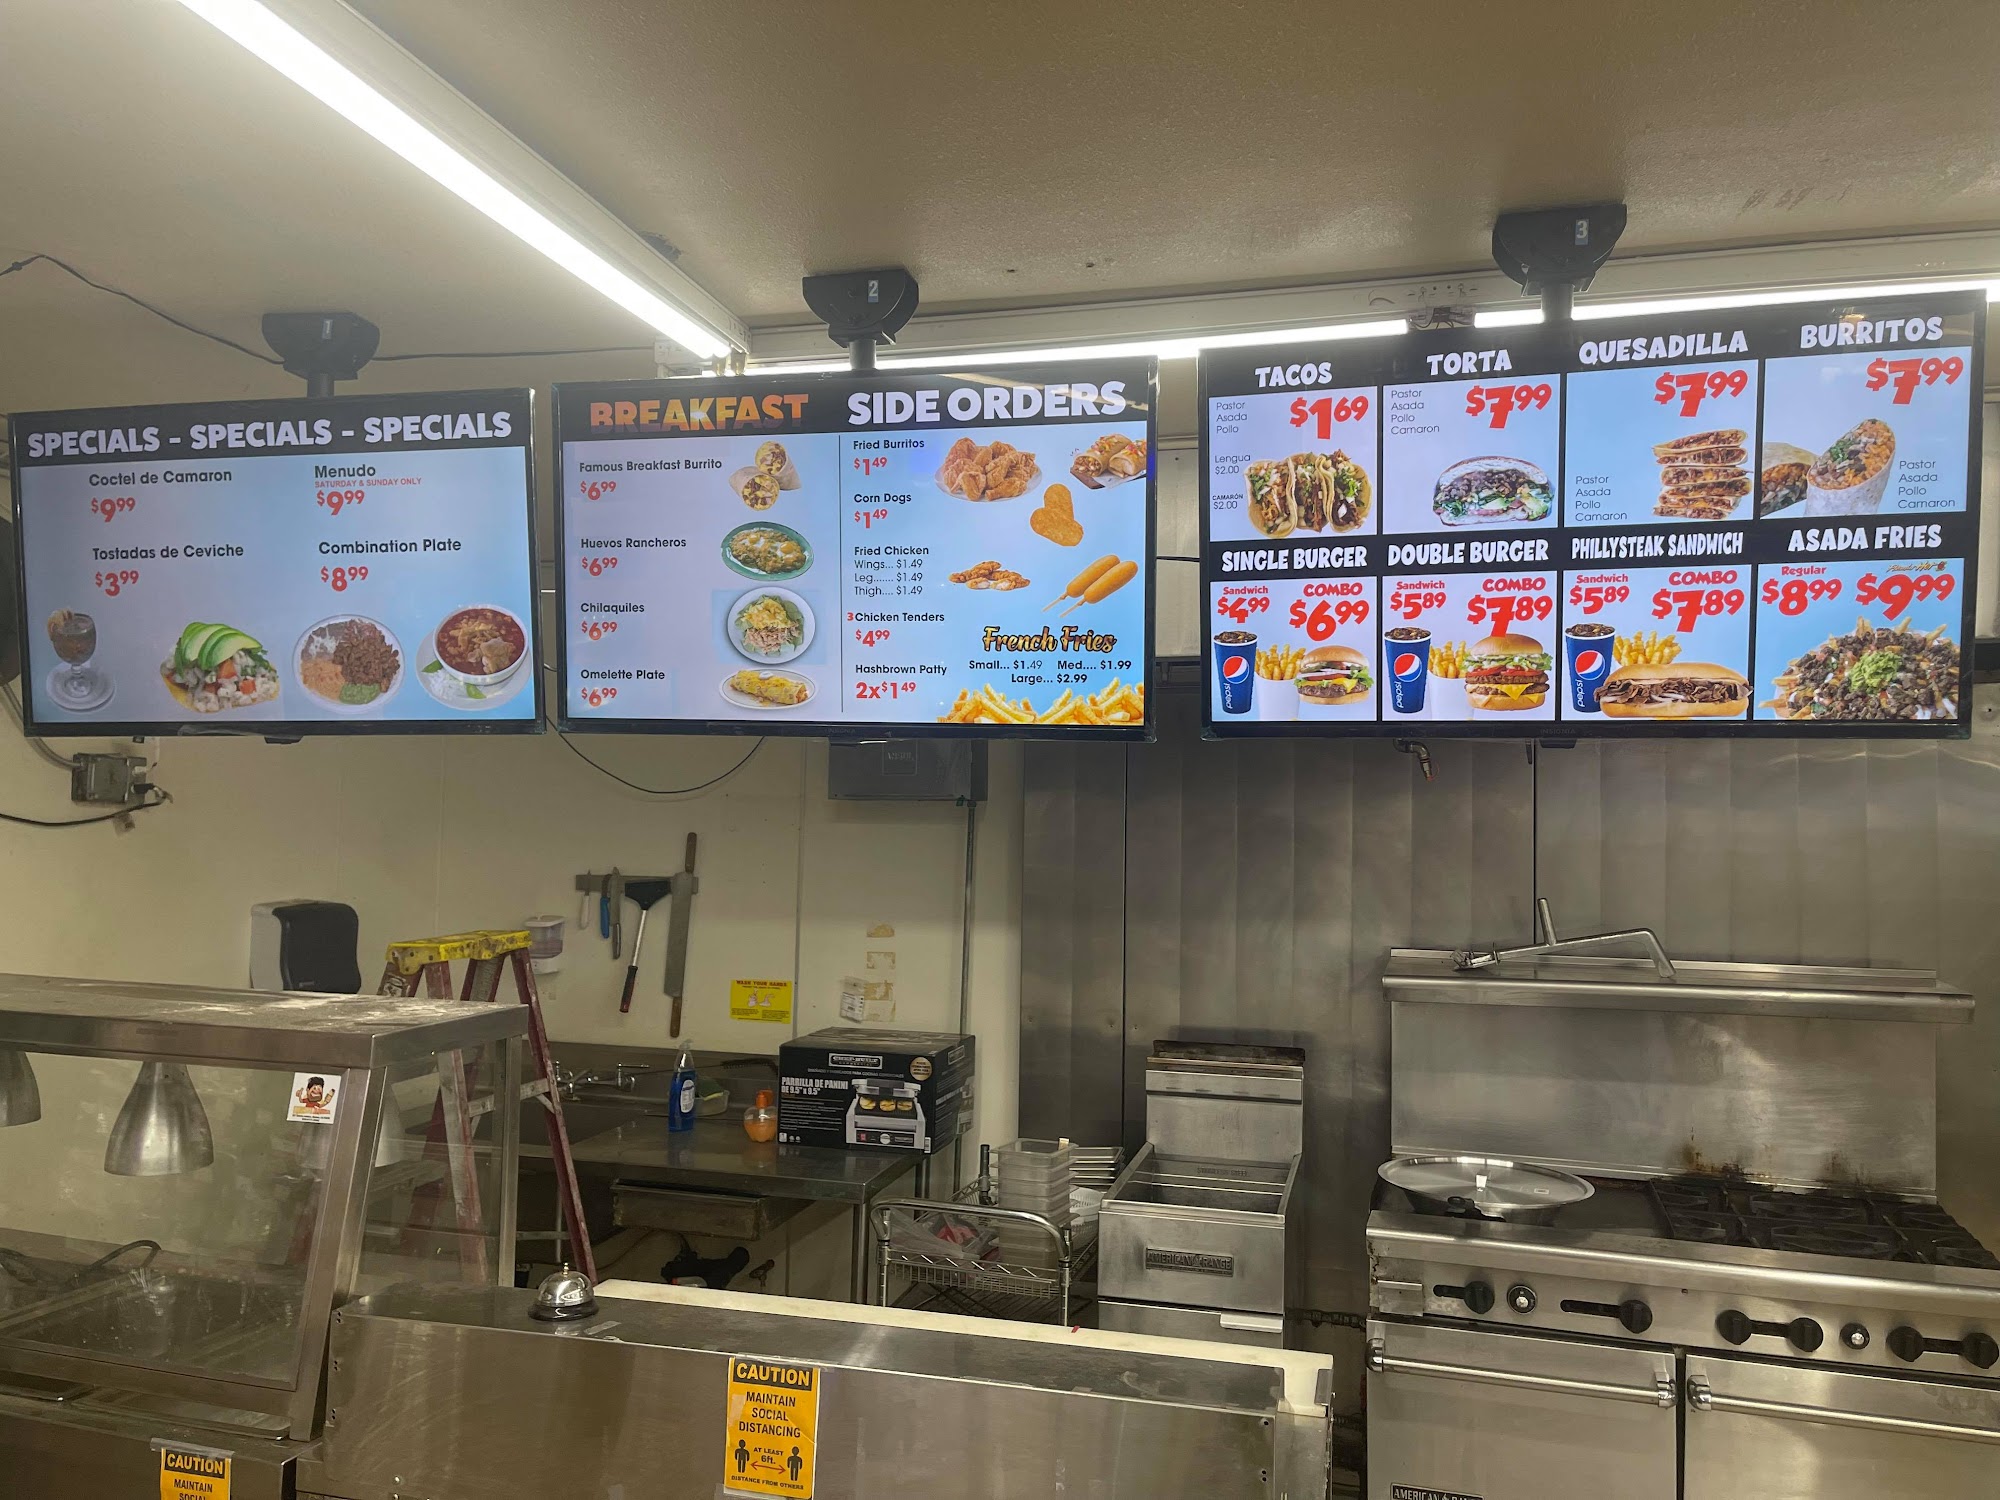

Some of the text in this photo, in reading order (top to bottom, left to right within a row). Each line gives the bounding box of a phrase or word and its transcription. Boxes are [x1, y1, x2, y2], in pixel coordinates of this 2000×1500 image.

[1576, 220, 1588, 239] 3
[868, 280, 878, 297] 2
[1800, 316, 1943, 349] BURRITOS
[1578, 330, 1749, 365] QUESADILLA
[1426, 349, 1512, 376] TORTA
[1254, 361, 1333, 388] TACOS
[1390, 388, 1422, 399] Pastor
[848, 381, 1127, 425] SIDE ORDERS
[1216, 401, 1245, 411] Pastor
[1390, 400, 1424, 411] Asada
[590, 393, 809, 434] BREAKFAST
[1216, 412, 1248, 422] Asada
[1390, 413, 1415, 423] Pollo
[27, 427, 160, 458] SPECIALS
[189, 419, 332, 450] SPECIALS
[363, 411, 512, 443] SPECIALS
[1216, 424, 1239, 434] Pollo
[1390, 424, 1440, 435] Camaron
[853, 438, 925, 450] Fried Burritos
[579, 458, 722, 472] Famous Breakfast Burrito
[1214, 453, 1251, 465] Lengua
[1899, 459, 1936, 470] Pastor
[314, 464, 376, 478] Menudo
[1214, 464, 1240, 475] $2.00
[89, 470, 232, 486] Coctel de Camaron
[314, 480, 357, 488] SATURDAY
[359, 479, 365, 487] &
[366, 479, 398, 487] SUNDAY
[1575, 474, 1609, 485] Pastor
[1898, 472, 1938, 483] Asada
[1575, 487, 1611, 497] Asada
[1898, 485, 1926, 496] Pollo
[854, 493, 912, 505] Corn Dogs
[1213, 499, 1238, 510] $2.00
[1575, 499, 1601, 510] Pollo
[1898, 498, 1956, 509] Camaron
[1575, 511, 1627, 522] Camaron
[581, 536, 686, 549] Huevos Rancheros
[1788, 524, 1942, 552] ASADA FRIES
[318, 538, 461, 554] Combination Plate
[854, 546, 929, 556] Fried Chicken
[1571, 531, 1744, 559] PHILLYSTEAK SANDWICH
[92, 544, 244, 560] Tostadas de Ceviche
[1388, 538, 1549, 566] DOUBLE BURGER
[896, 559, 923, 569] $1.49
[1222, 546, 1368, 572] SINGLE BURGER
[896, 572, 923, 582] $1.49
[1781, 565, 1827, 577] Regular
[1482, 576, 1546, 592] COMBO
[1576, 573, 1628, 584] Sandwich
[1669, 570, 1737, 587] COMBO
[896, 585, 923, 595] $1.49
[1223, 585, 1268, 595] Sandwich
[1303, 582, 1363, 597] COMBO
[1396, 580, 1445, 591] Sandwich
[580, 602, 645, 615] Chilaquiles
[855, 612, 899, 622] Chicken
[902, 612, 945, 622] Tenders
[982, 625, 1117, 653] French Fries
[855, 664, 947, 677] Hashbrown Patty
[968, 659, 1010, 670] Small...
[1013, 659, 1043, 670] $1.49
[1100, 659, 1132, 670] $1.99
[580, 669, 665, 680] Omelette Plate
[1011, 673, 1087, 685] Large... $2.99
[1223, 683, 1233, 709] pepsi
[1394, 680, 1404, 709] pepsi
[1575, 679, 1585, 707] pepsi
[781, 1077, 849, 1090] PARRILLA DE PANINI
[781, 1085, 789, 1093] DE
[1147, 1252, 1232, 1269] AMERICAN RANGE
[736, 1362, 810, 1386] CAUTION
[746, 1391, 796, 1407] MAINTAIN
[751, 1407, 789, 1421] SOCIAL
[738, 1421, 801, 1438] DISTANCING
[764, 1448, 784, 1456] LEAST
[166, 1453, 223, 1475] CAUTION
[761, 1455, 776, 1464] 6ft.
[174, 1479, 213, 1493] MAINTAIN
[731, 1475, 760, 1484] DISTANCE
[762, 1478, 778, 1487] FROM
